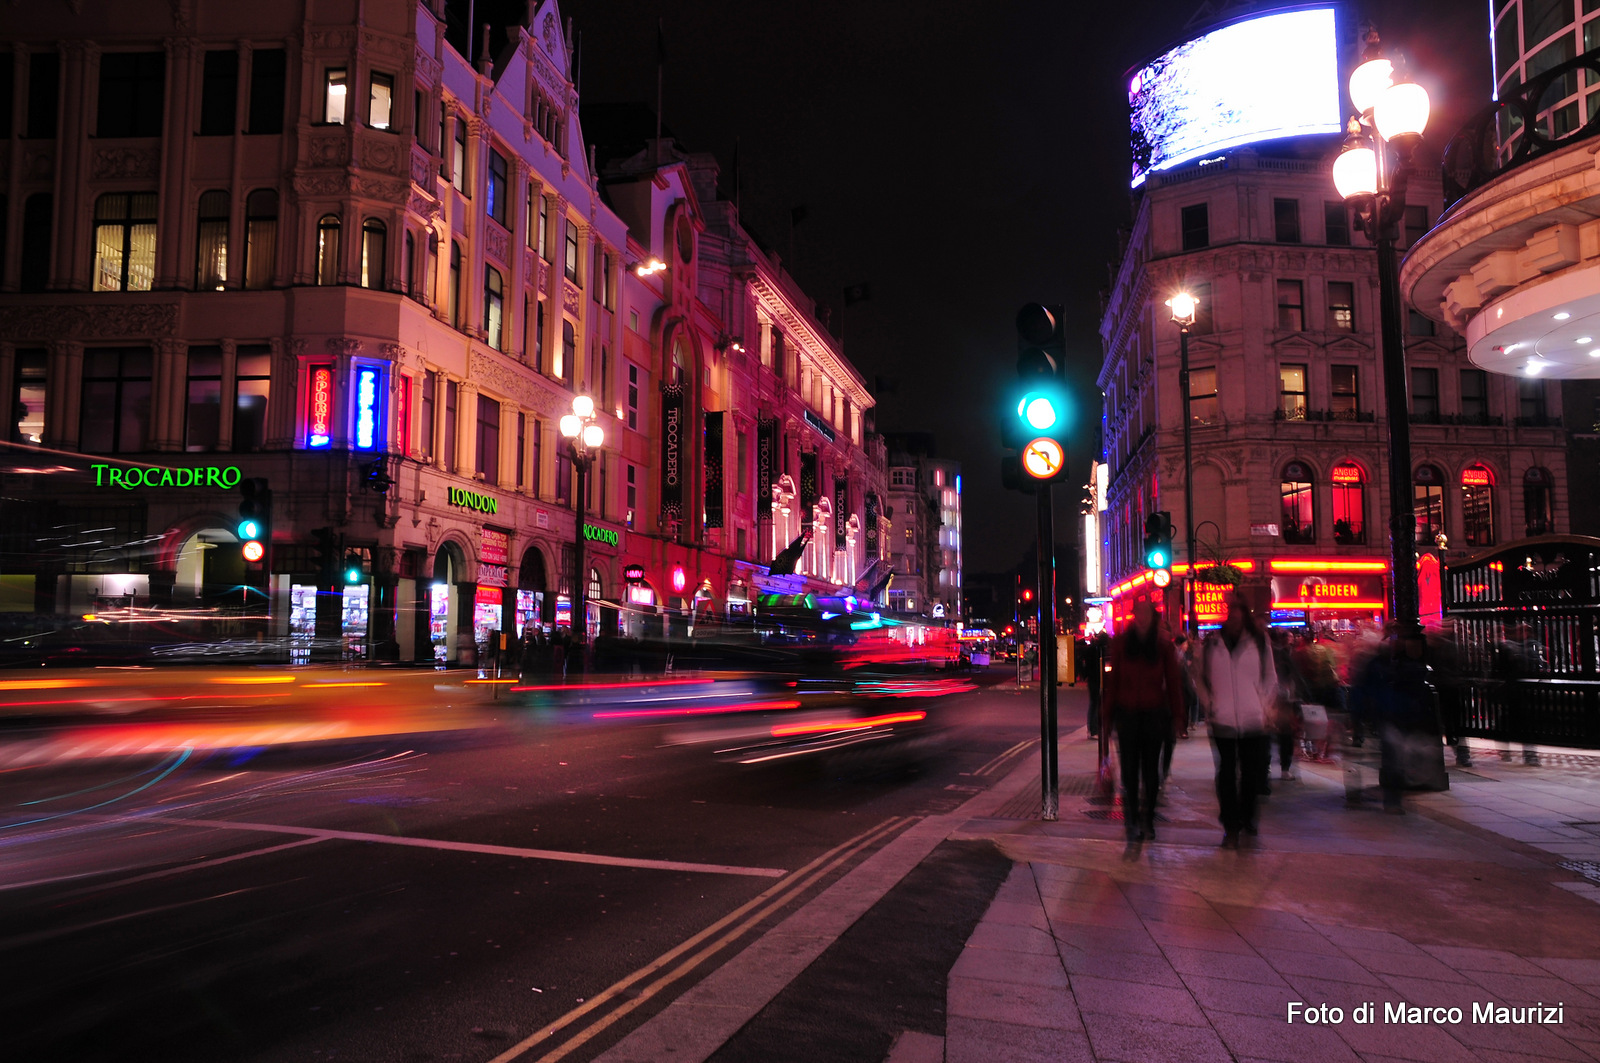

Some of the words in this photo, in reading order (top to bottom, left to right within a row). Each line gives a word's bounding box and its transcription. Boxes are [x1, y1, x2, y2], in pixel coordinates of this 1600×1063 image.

[315, 369, 329, 434] SPORTS
[667, 407, 678, 486] TROCADERO
[91, 464, 242, 490] TROCADERO
[760, 437, 769, 498] TROCADERO
[1333, 467, 1359, 477] ANGUS
[450, 486, 498, 514] LONDON
[583, 523, 619, 547] ROCADERO
[479, 566, 505, 579] IMPERIAL
[626, 570, 643, 578] HMV
[1300, 584, 1358, 597] AERDEEN
